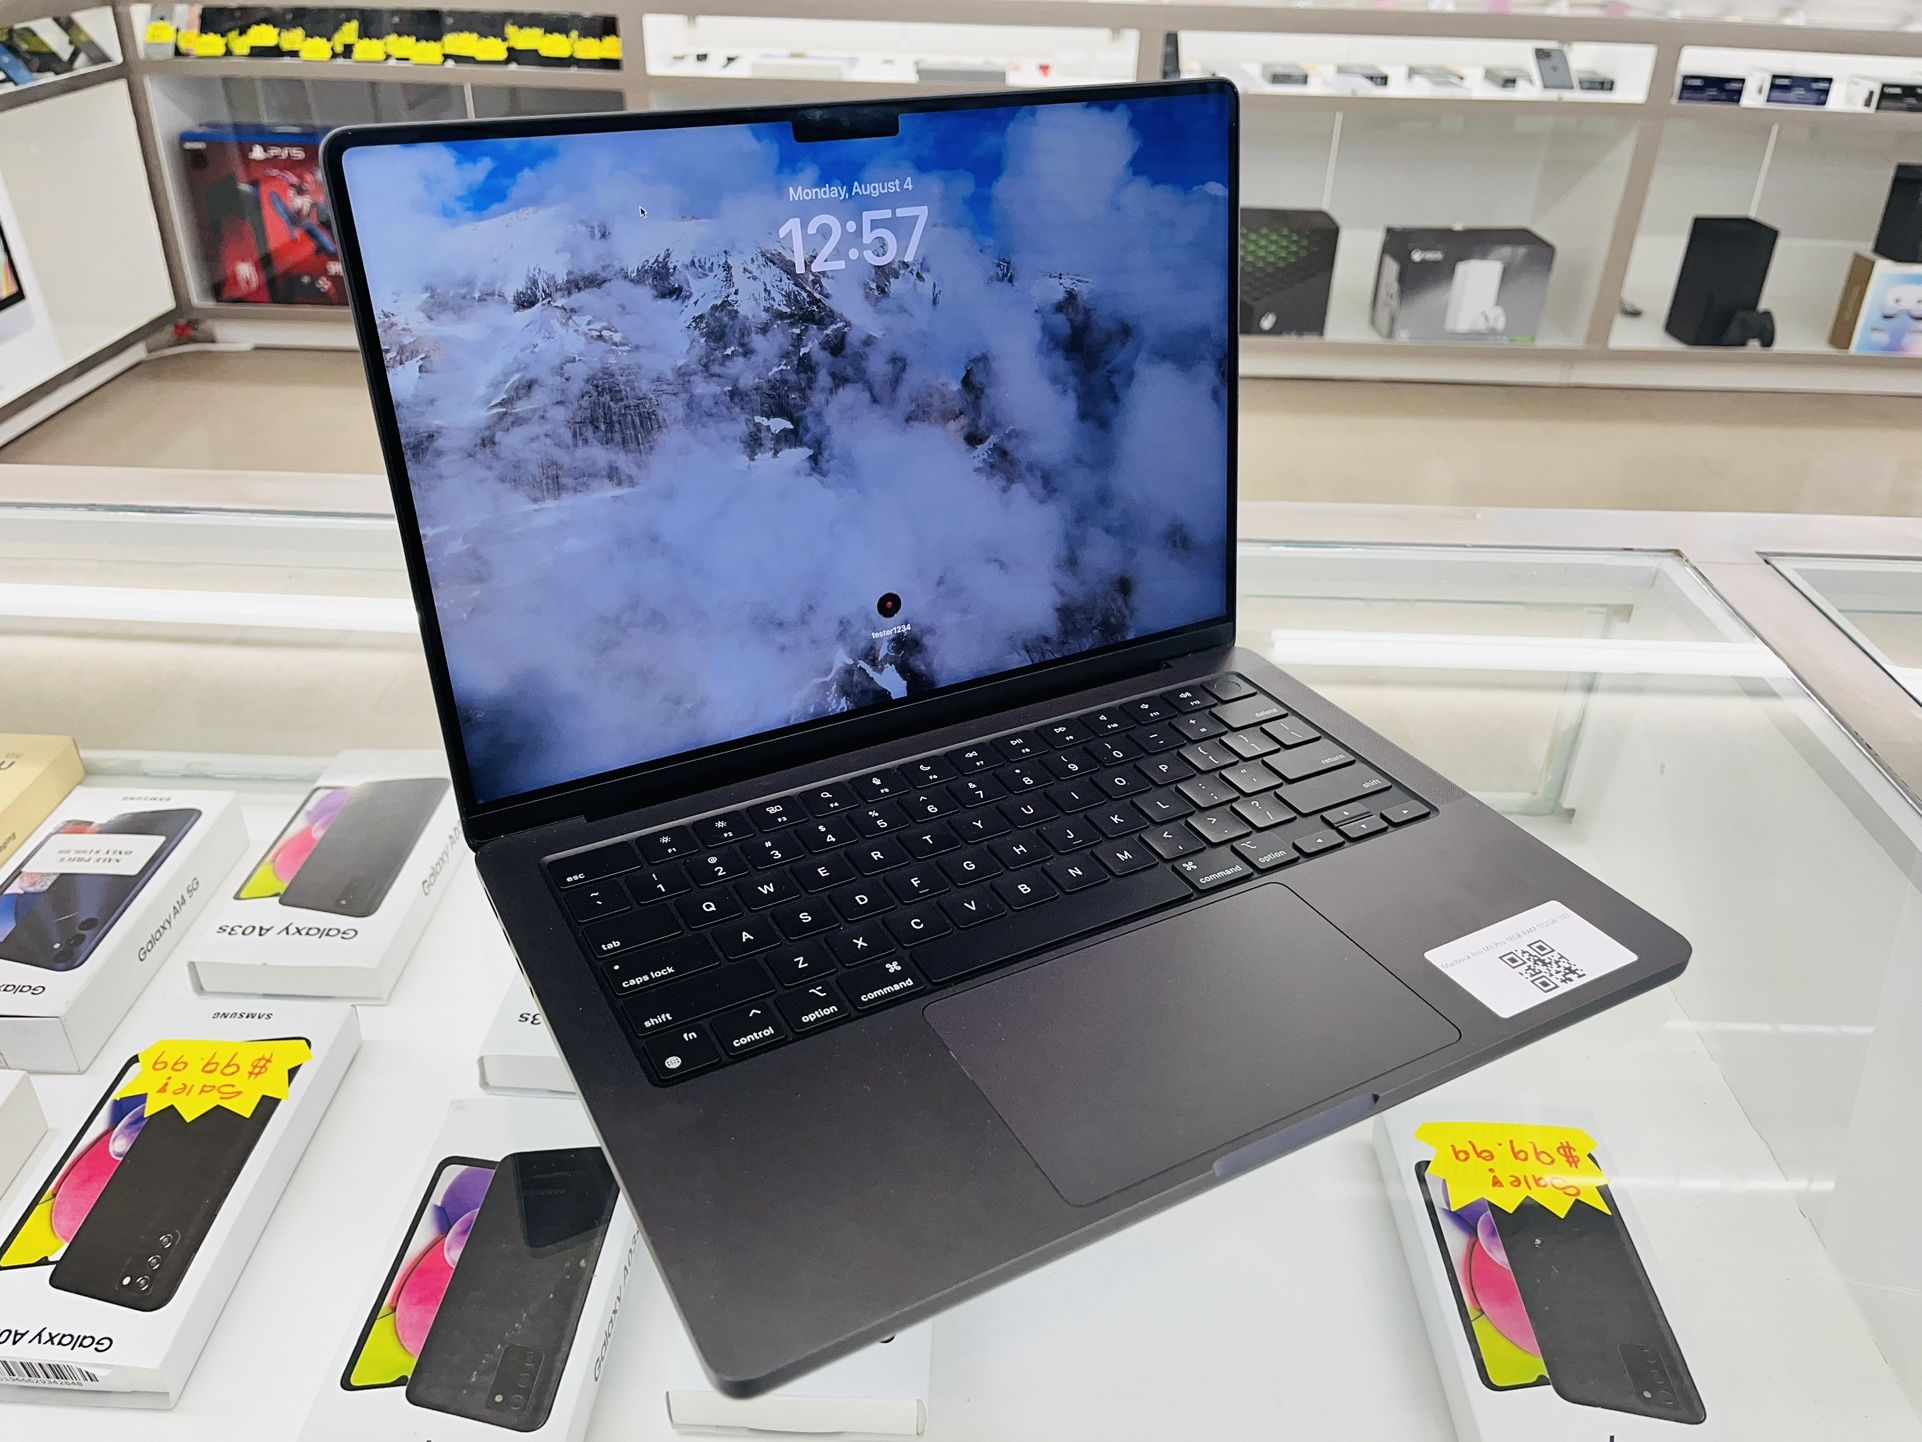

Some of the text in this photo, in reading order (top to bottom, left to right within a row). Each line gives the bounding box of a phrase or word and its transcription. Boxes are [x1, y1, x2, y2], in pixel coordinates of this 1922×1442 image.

[788, 176, 913, 201] Monday, August 4
[778, 205, 929, 274] 12:57
[871, 623, 911, 639] tester1234
[1320, 754, 1346, 765] return
[1158, 764, 1169, 773] P
[1022, 776, 1034, 785] 8
[1362, 779, 1382, 789] shift
[974, 790, 984, 799] 7
[926, 804, 938, 813] 6
[1020, 805, 1034, 815] U
[876, 819, 888, 828] 5
[972, 819, 983, 829] Y
[1110, 814, 1124, 824] K
[922, 834, 933, 844] T
[1066, 829, 1075, 839] J
[770, 850, 782, 859] 3
[1012, 844, 1028, 855] H
[870, 850, 884, 861] R
[1116, 850, 1133, 862] M
[1258, 850, 1287, 864] option
[421, 844, 451, 897] Galaxy
[714, 866, 727, 876] 2
[962, 860, 976, 871] G
[566, 872, 586, 882] esc
[817, 866, 830, 877] E
[1067, 866, 1083, 878] N
[1199, 864, 1243, 884] command
[656, 883, 666, 893] 1
[910, 877, 921, 888] F
[757, 882, 774, 895] W
[1017, 883, 1032, 894] B
[854, 894, 869, 905] D
[702, 901, 717, 912] Q
[963, 900, 976, 911] V
[137, 876, 199, 962] Galaxy A14 5G
[799, 912, 812, 923] S
[910, 918, 924, 930] C
[216, 922, 359, 941] Galaxy A03s
[742, 931, 754, 943] A
[601, 940, 621, 951] tab
[852, 936, 868, 949] X
[793, 956, 809, 969] Z
[622, 966, 675, 988] caps lock
[860, 977, 914, 1002] command
[211, 1011, 274, 1021] SAMSUNG
[801, 1005, 838, 1023] option
[643, 1012, 673, 1028] shift
[682, 1031, 698, 1042] fn
[732, 1025, 775, 1047] control
[593, 1284, 622, 1383] Galaxy
[27, 1326, 114, 1353] Galaxy
